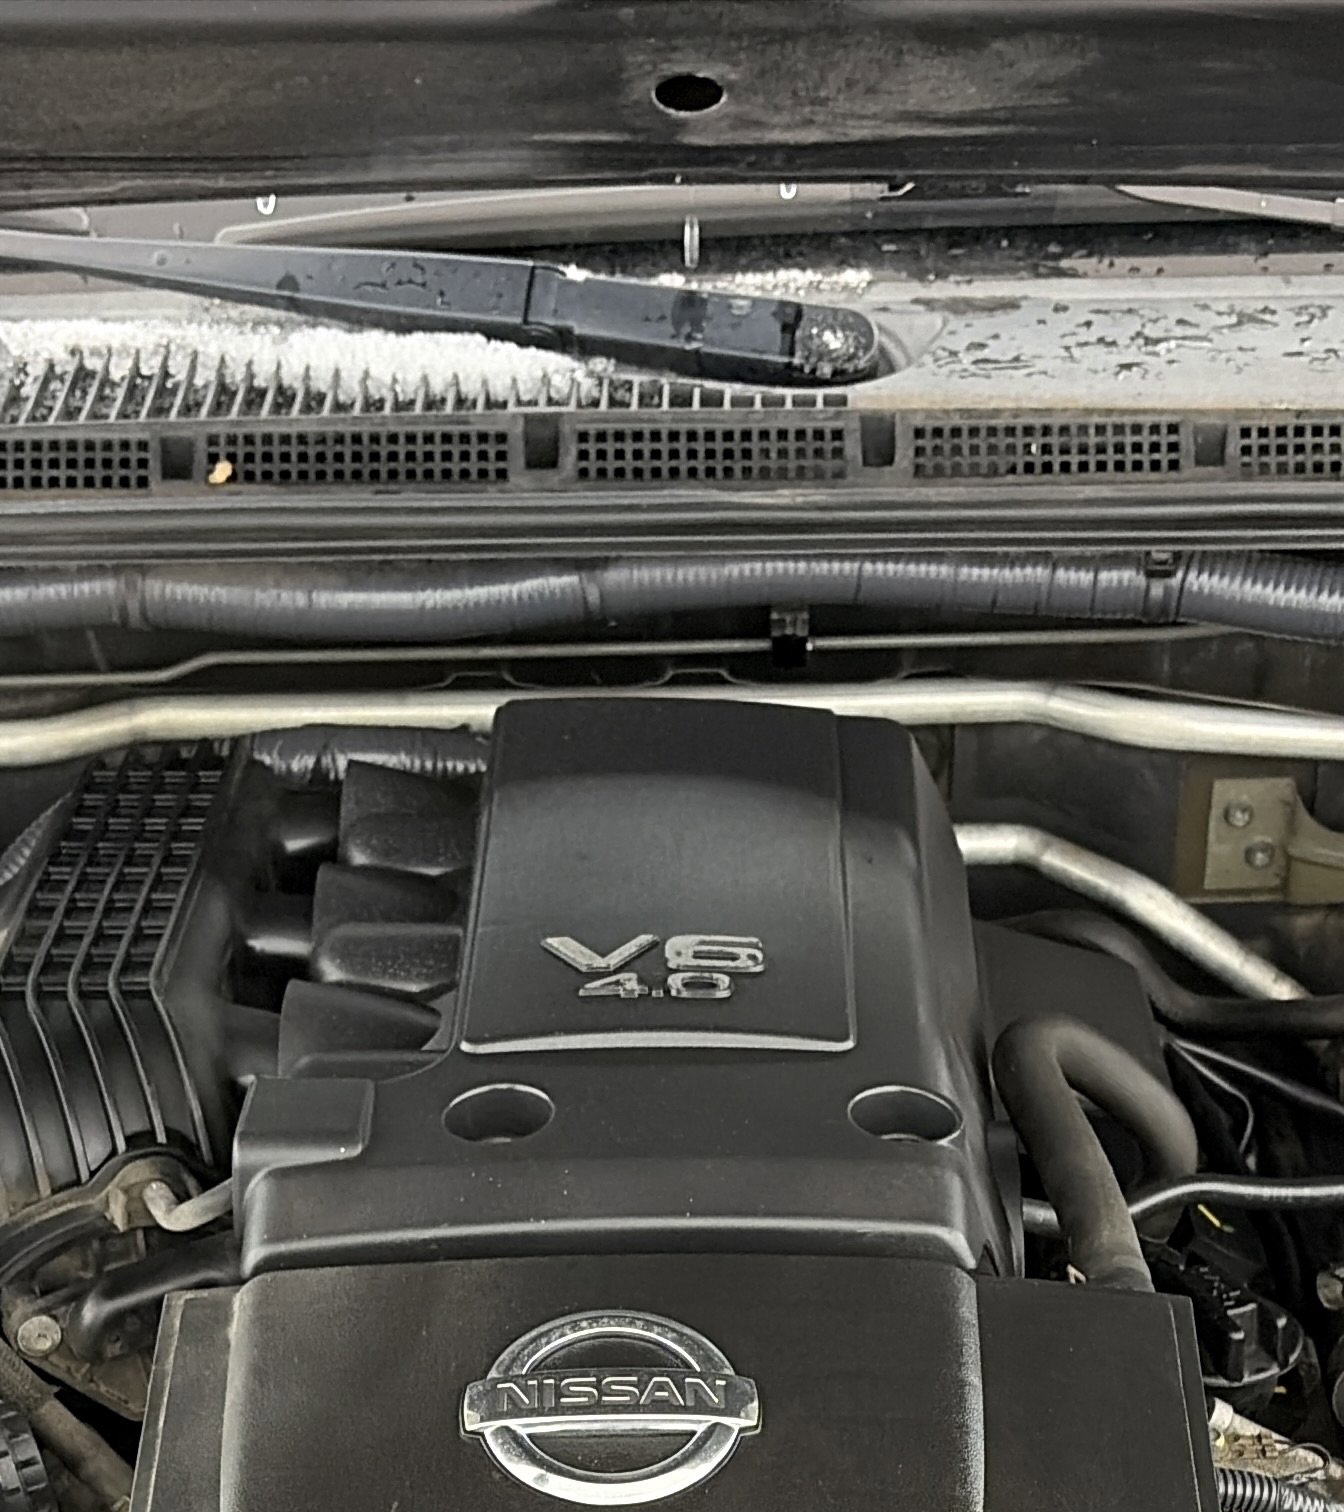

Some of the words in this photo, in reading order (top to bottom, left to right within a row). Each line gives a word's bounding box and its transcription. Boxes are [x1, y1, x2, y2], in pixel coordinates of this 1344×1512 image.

[540, 933, 766, 973] V6
[578, 972, 734, 999] 4.0
[496, 1377, 726, 1409] NISSAN
